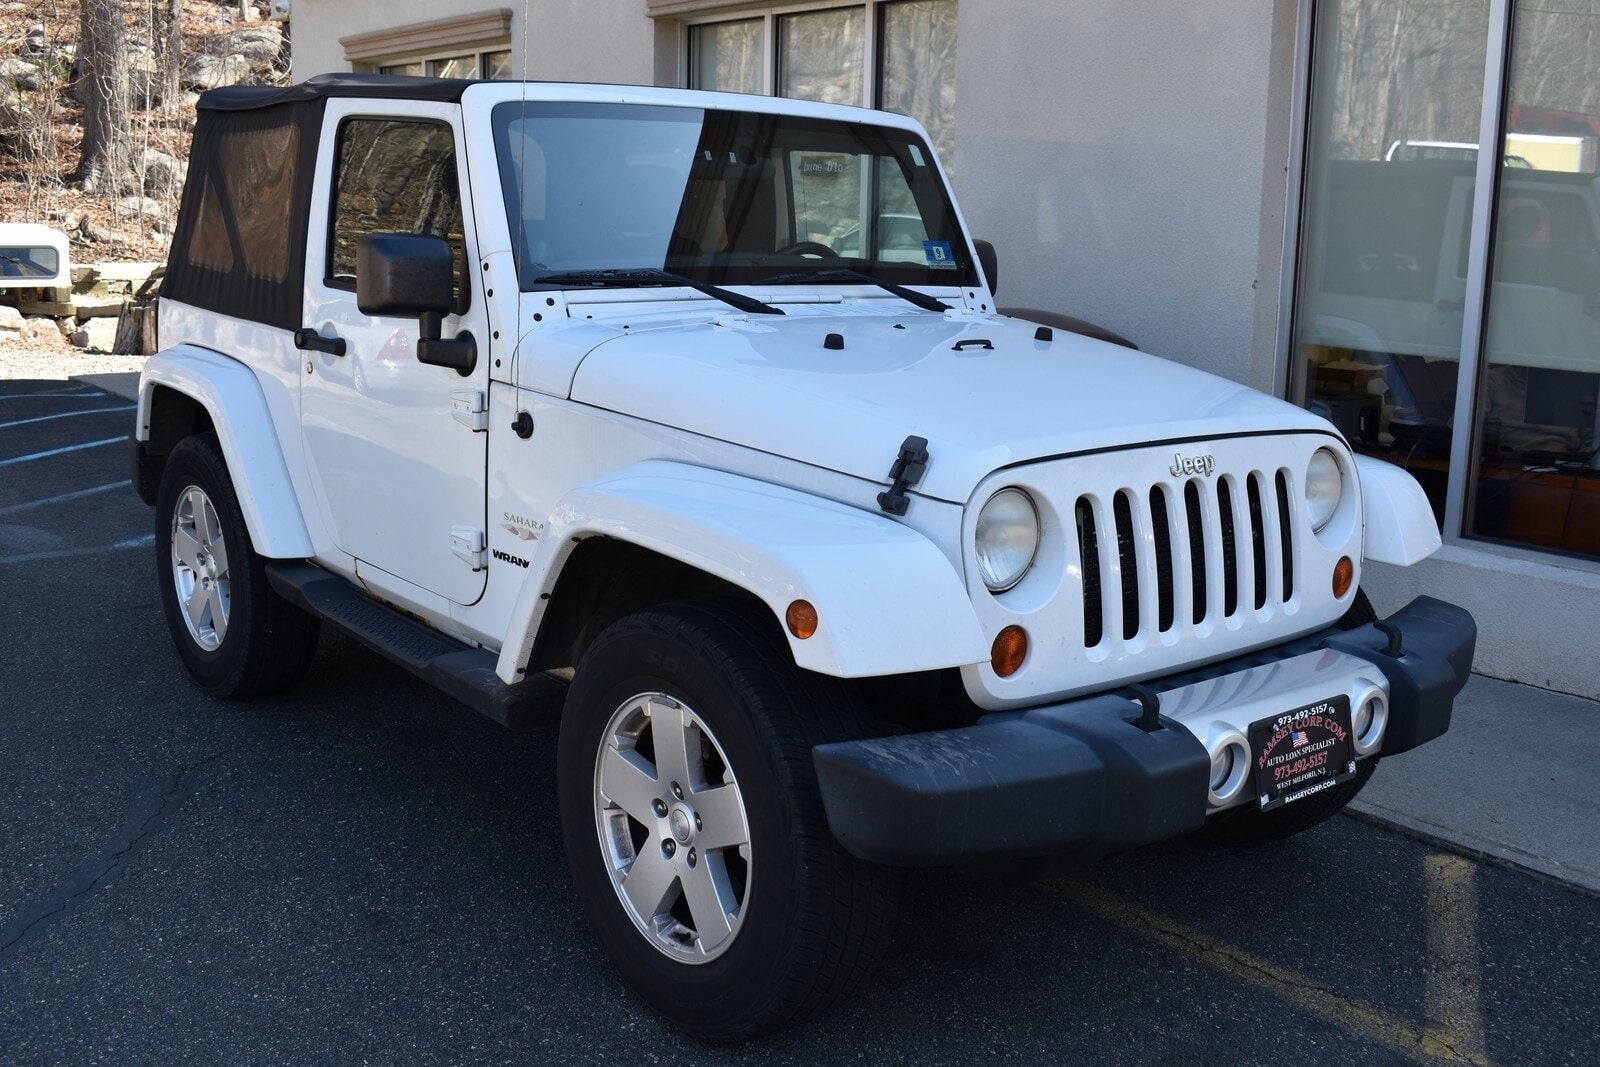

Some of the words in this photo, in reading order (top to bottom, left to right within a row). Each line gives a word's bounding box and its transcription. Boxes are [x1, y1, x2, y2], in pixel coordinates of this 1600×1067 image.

[1169, 453, 1215, 477] Jeep
[503, 512, 545, 529] SAHARA
[1278, 703, 1328, 726] 973-492-5157
[1259, 721, 1294, 769] RAMSEY
[1324, 718, 1347, 742] COM
[1266, 754, 1285, 768] AUTO
[1285, 747, 1302, 762] LOAN
[1301, 737, 1336, 755] SPECIALIST
[1274, 750, 1328, 781] 973-492-5157
[1276, 780, 1292, 789] WEST
[1285, 780, 1336, 803] RAMSEYCORP.COM
